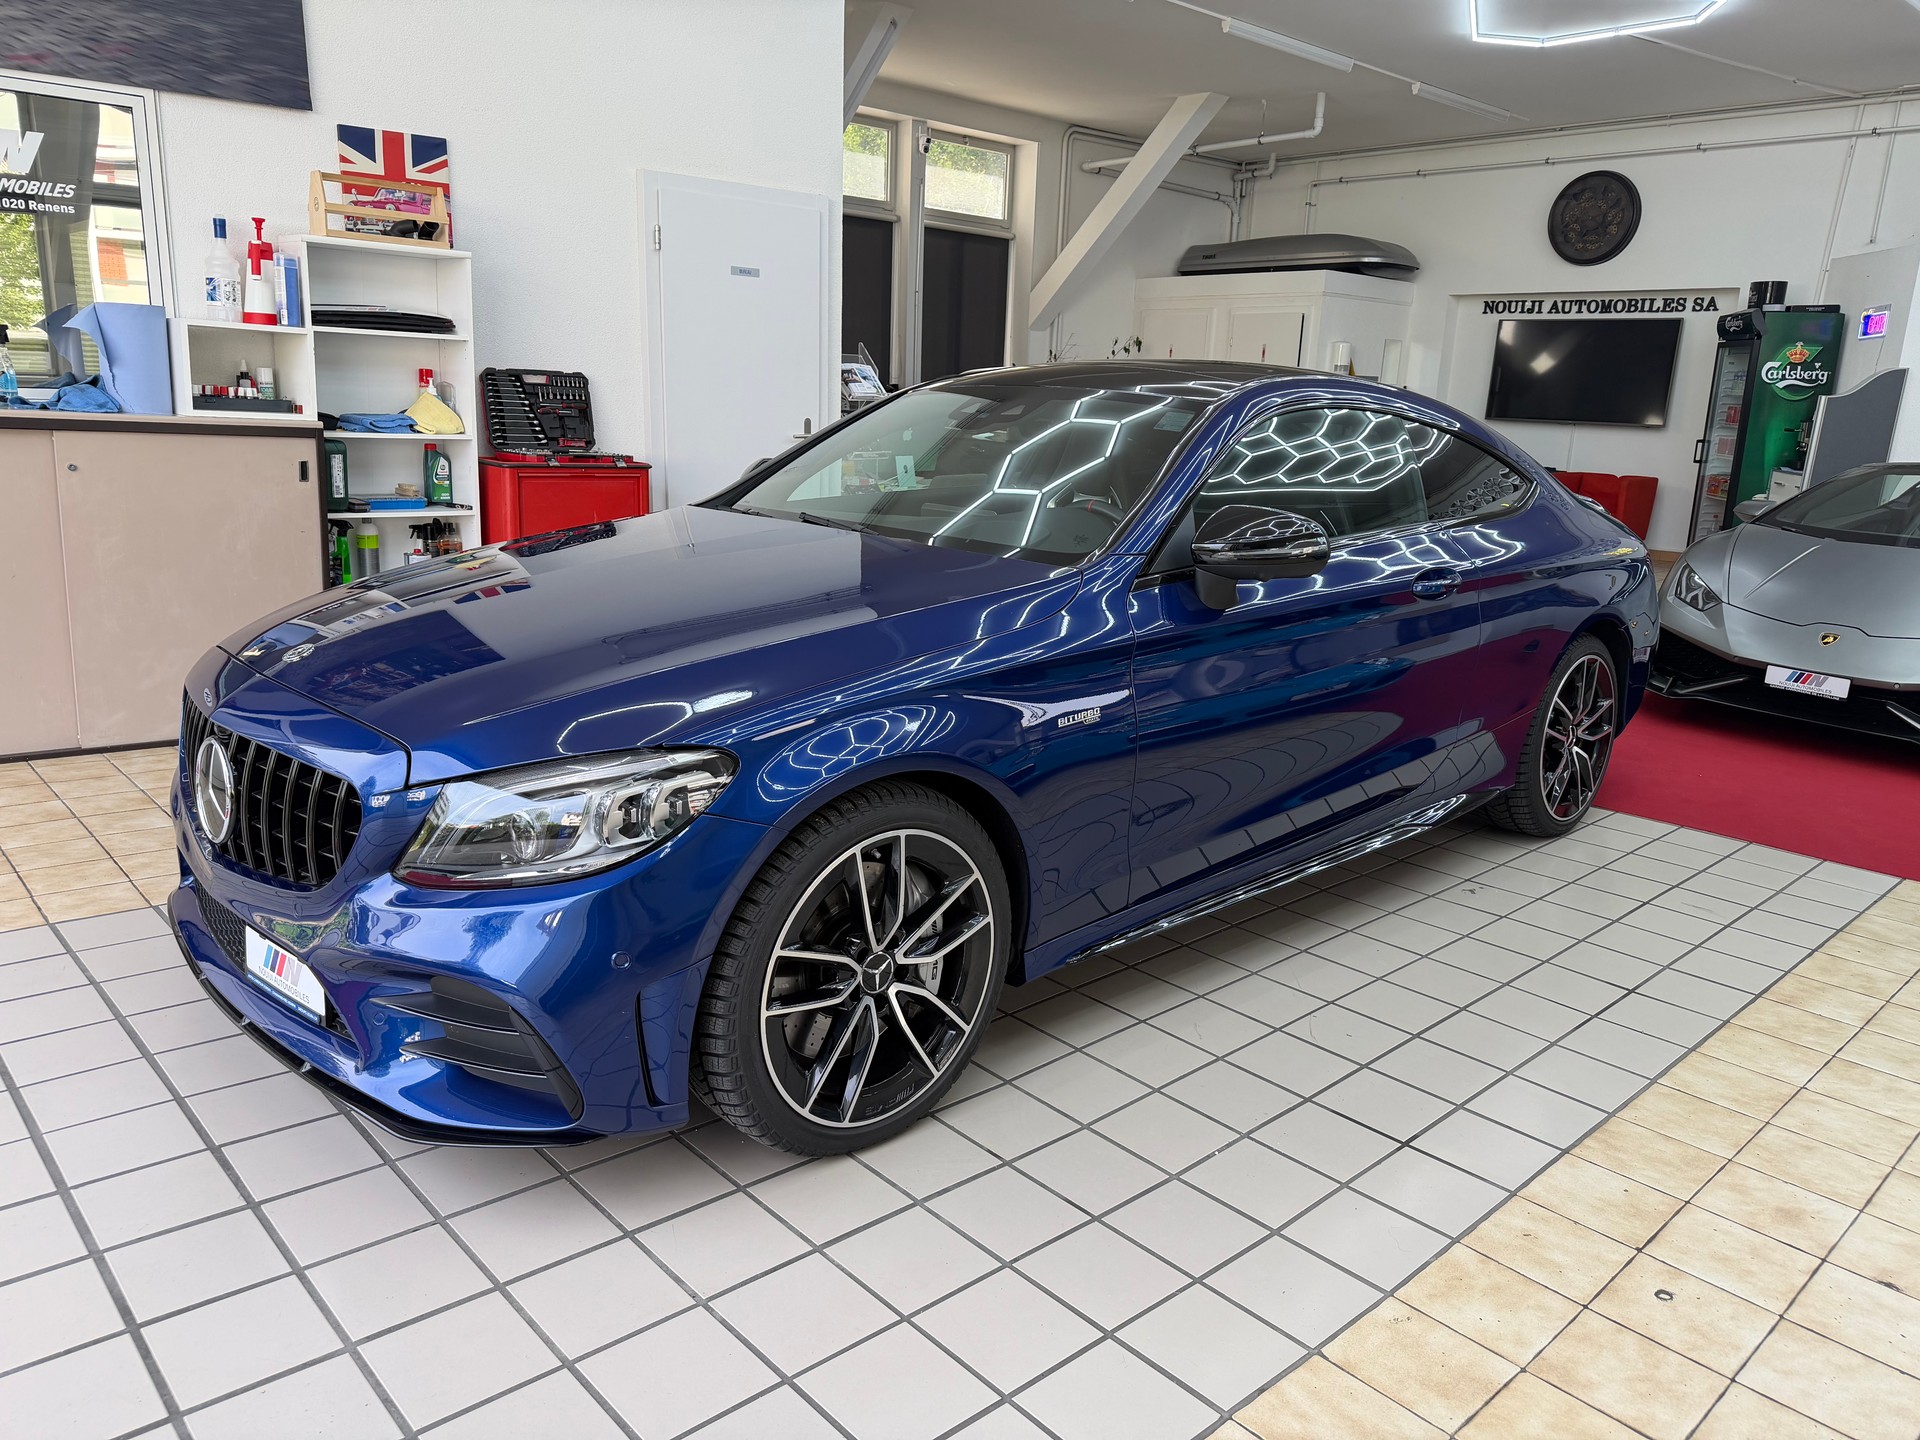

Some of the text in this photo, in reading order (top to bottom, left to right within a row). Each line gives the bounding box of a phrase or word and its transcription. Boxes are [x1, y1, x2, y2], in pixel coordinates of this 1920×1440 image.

[0, 198, 76, 214] 020 Renens
[1482, 296, 1719, 314] NOUIJI AUTOMOBILES SA
[1868, 314, 1886, 333] BAR
[1761, 361, 1828, 387] Carlsberg
[1058, 708, 1100, 726] BITURBO
[274, 977, 310, 1004] AUTOMOBILES
